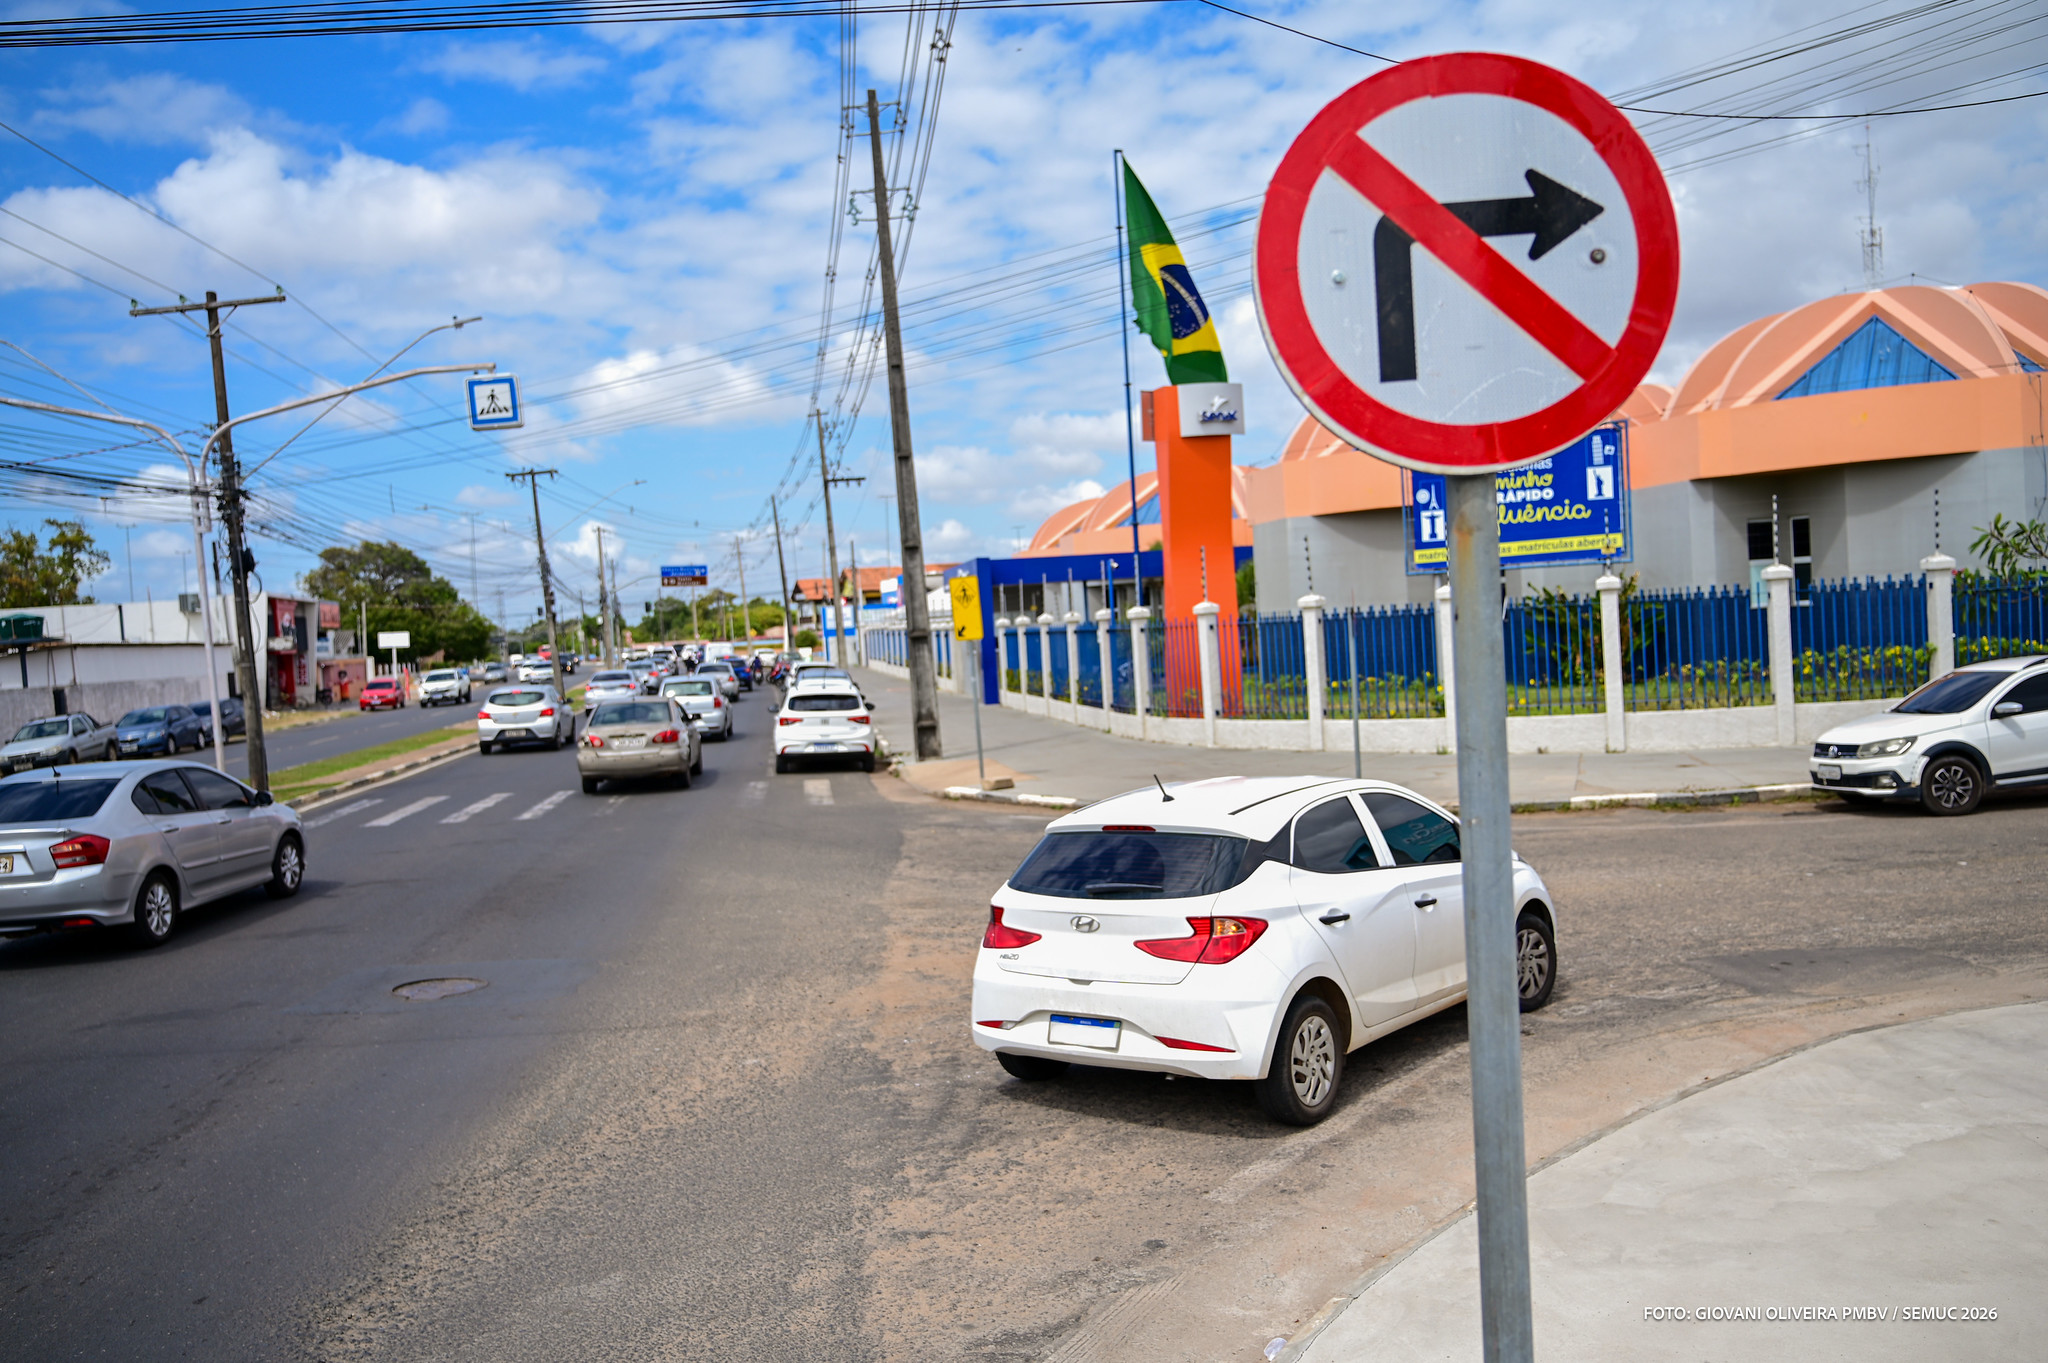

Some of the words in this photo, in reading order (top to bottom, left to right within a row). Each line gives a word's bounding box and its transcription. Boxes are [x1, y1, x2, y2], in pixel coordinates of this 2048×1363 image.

[1495, 470, 1554, 490] minho
[1496, 499, 1592, 530] luência
[1577, 535, 1618, 548] aberts
